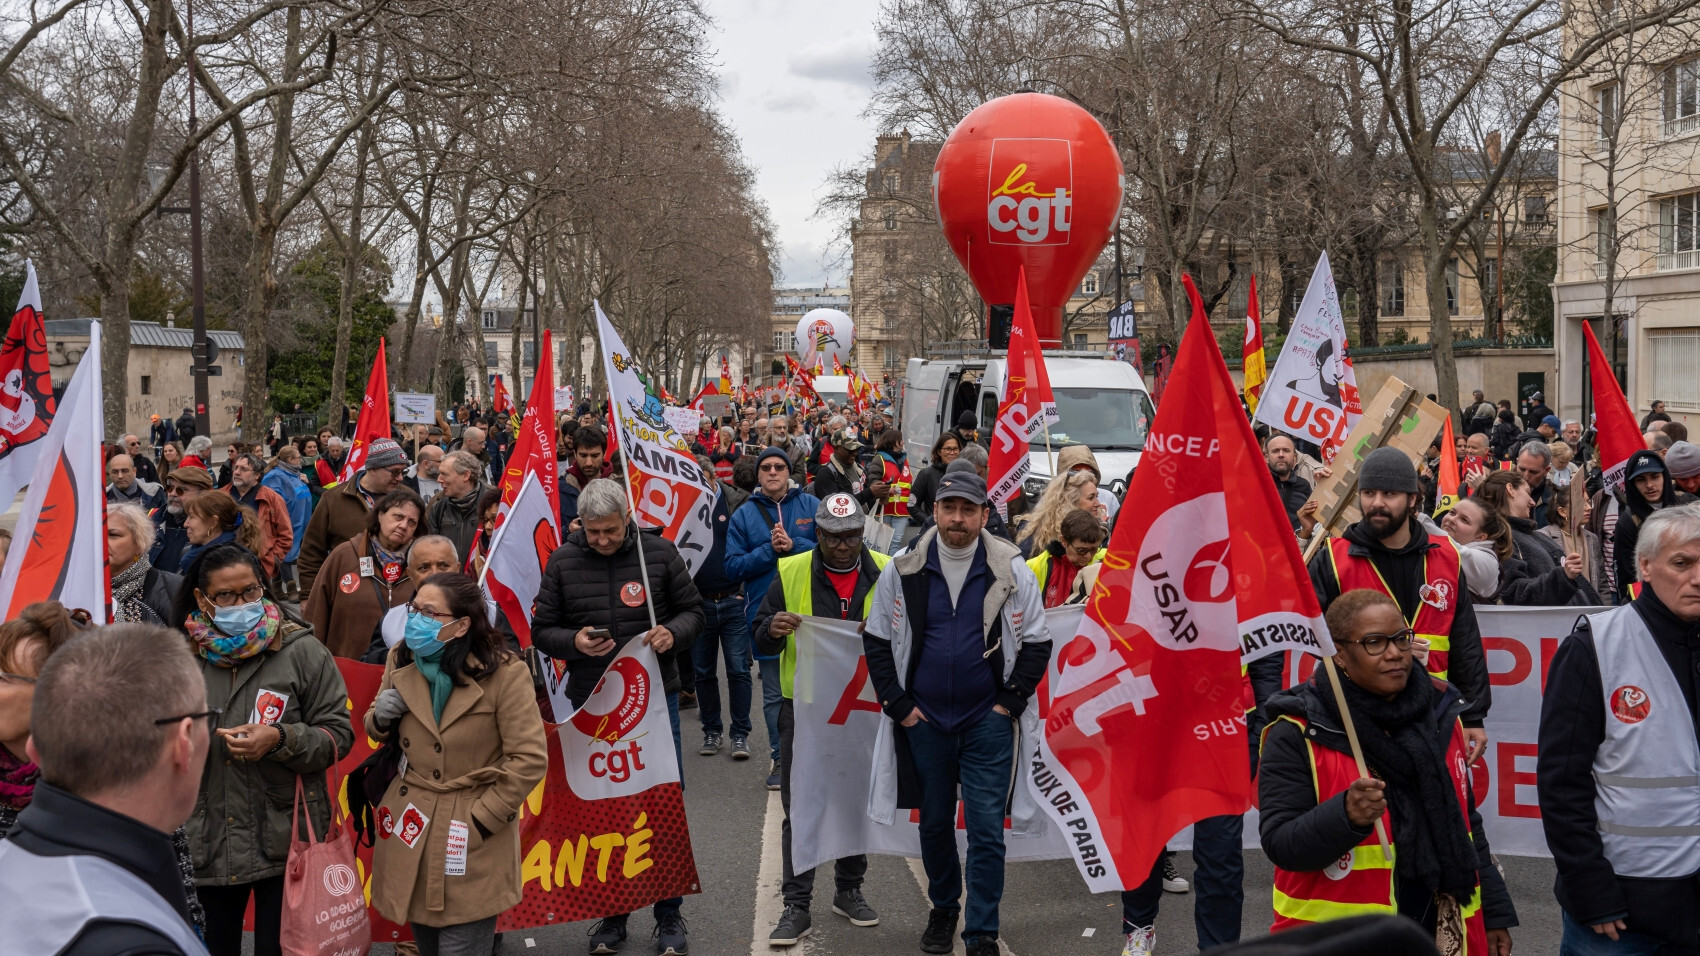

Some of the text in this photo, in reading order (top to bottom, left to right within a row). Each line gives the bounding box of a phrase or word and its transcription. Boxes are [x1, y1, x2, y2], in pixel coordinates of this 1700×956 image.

[988, 188, 1072, 243] cgt
[832, 505, 848, 516] cgt
[1140, 551, 1199, 644] USAP
[620, 672, 647, 731] ACTION SOCIALE
[588, 740, 646, 784] cgt
[1050, 781, 1080, 816] DE
[1066, 816, 1107, 880] PARIS
